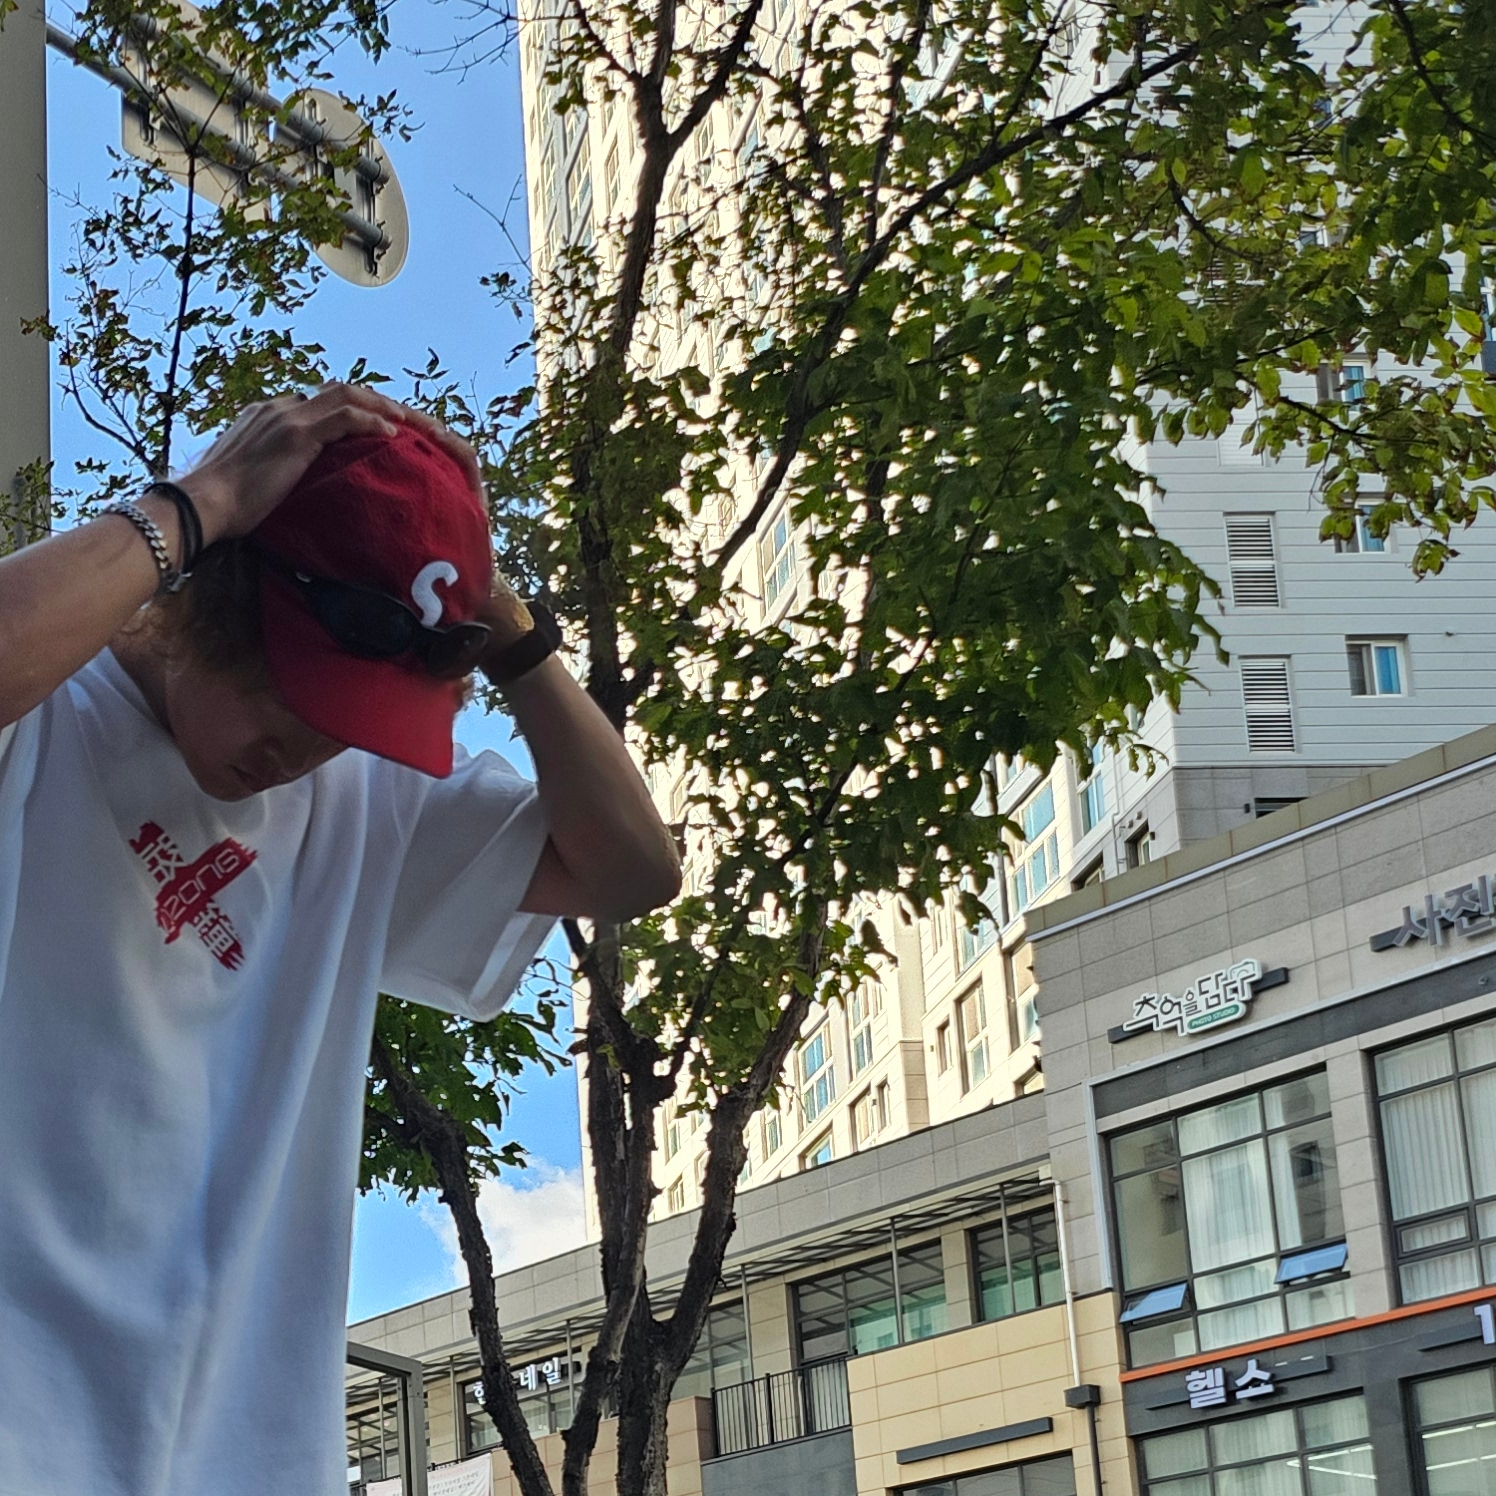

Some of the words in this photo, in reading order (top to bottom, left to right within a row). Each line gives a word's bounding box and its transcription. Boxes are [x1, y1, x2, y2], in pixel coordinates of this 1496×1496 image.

[1392, 873, 1496, 948] 사진
[1191, 1014, 1213, 1027] PHOTO
[1212, 1007, 1237, 1020] STUDIO
[1185, 1359, 1274, 1409] 헬스
